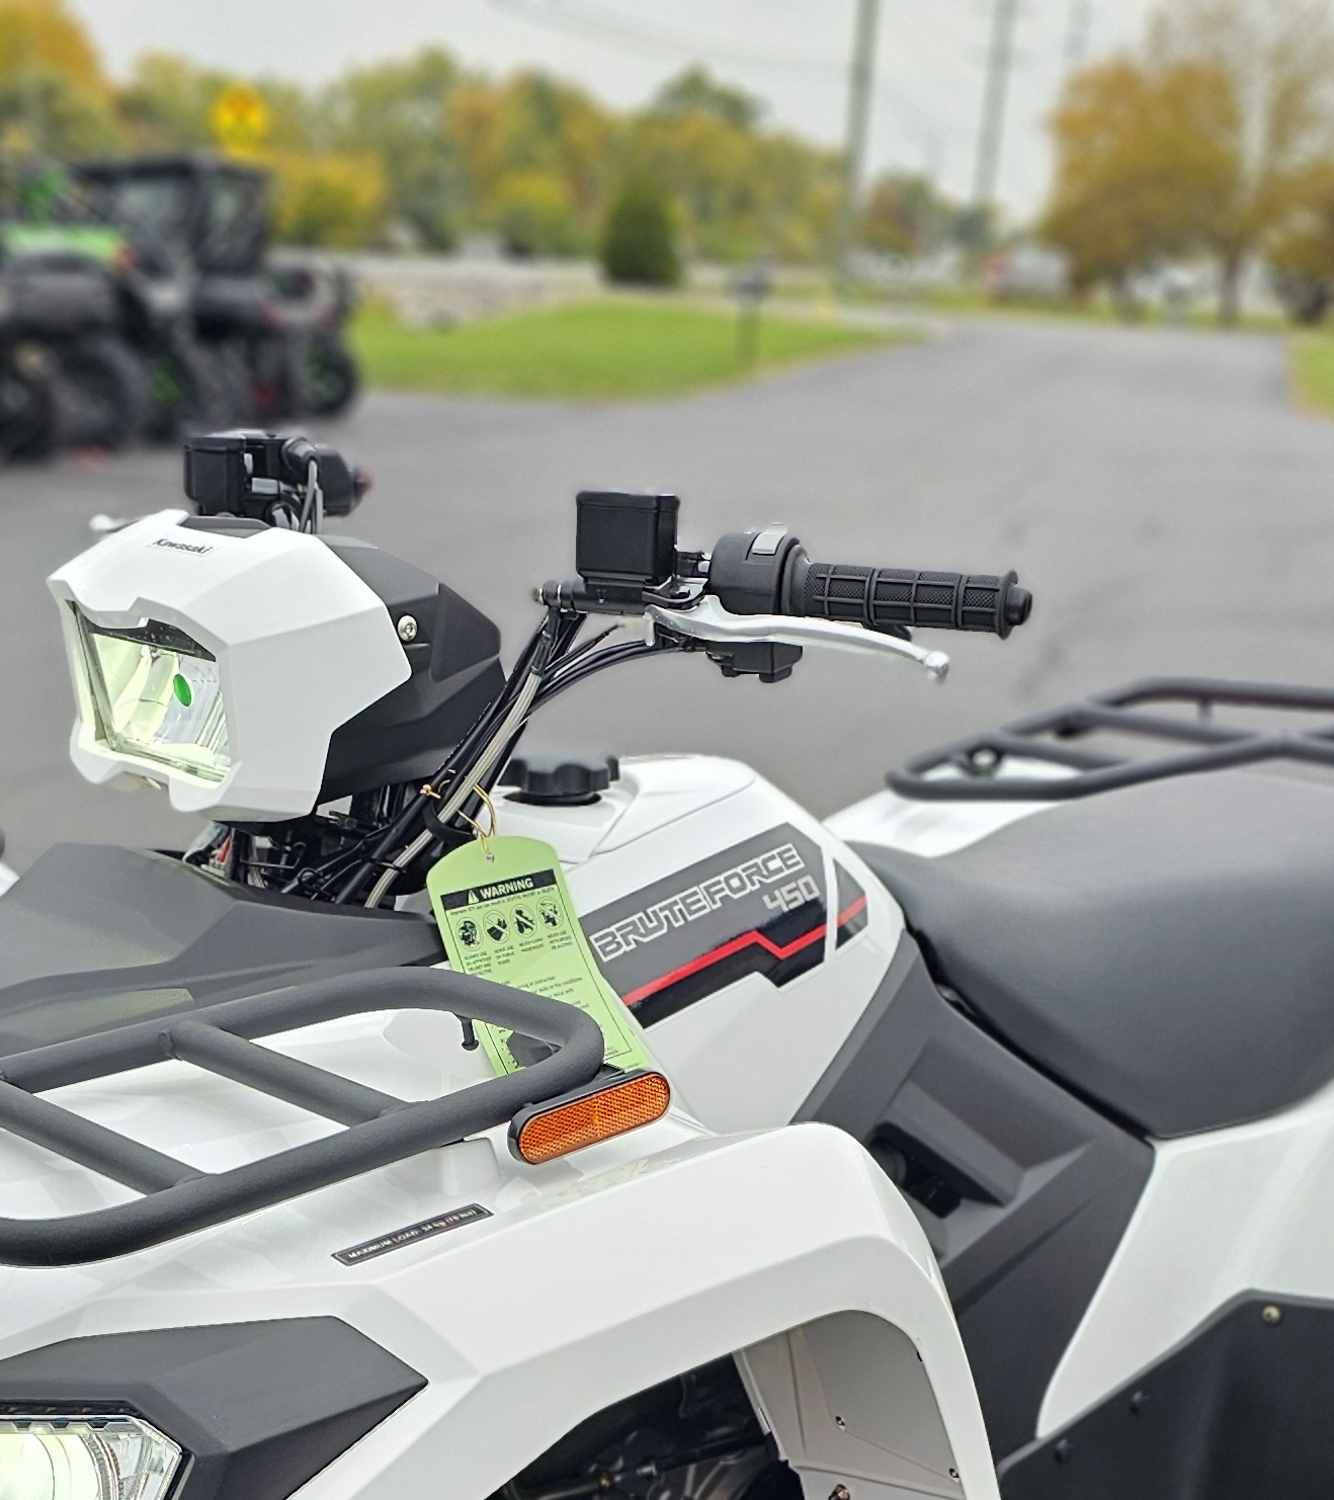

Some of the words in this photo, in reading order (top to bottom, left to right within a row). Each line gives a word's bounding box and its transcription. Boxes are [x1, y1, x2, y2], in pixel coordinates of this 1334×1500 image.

[152, 538, 213, 554] Kawasaki
[479, 878, 534, 900] WARNING
[762, 875, 820, 913] 450
